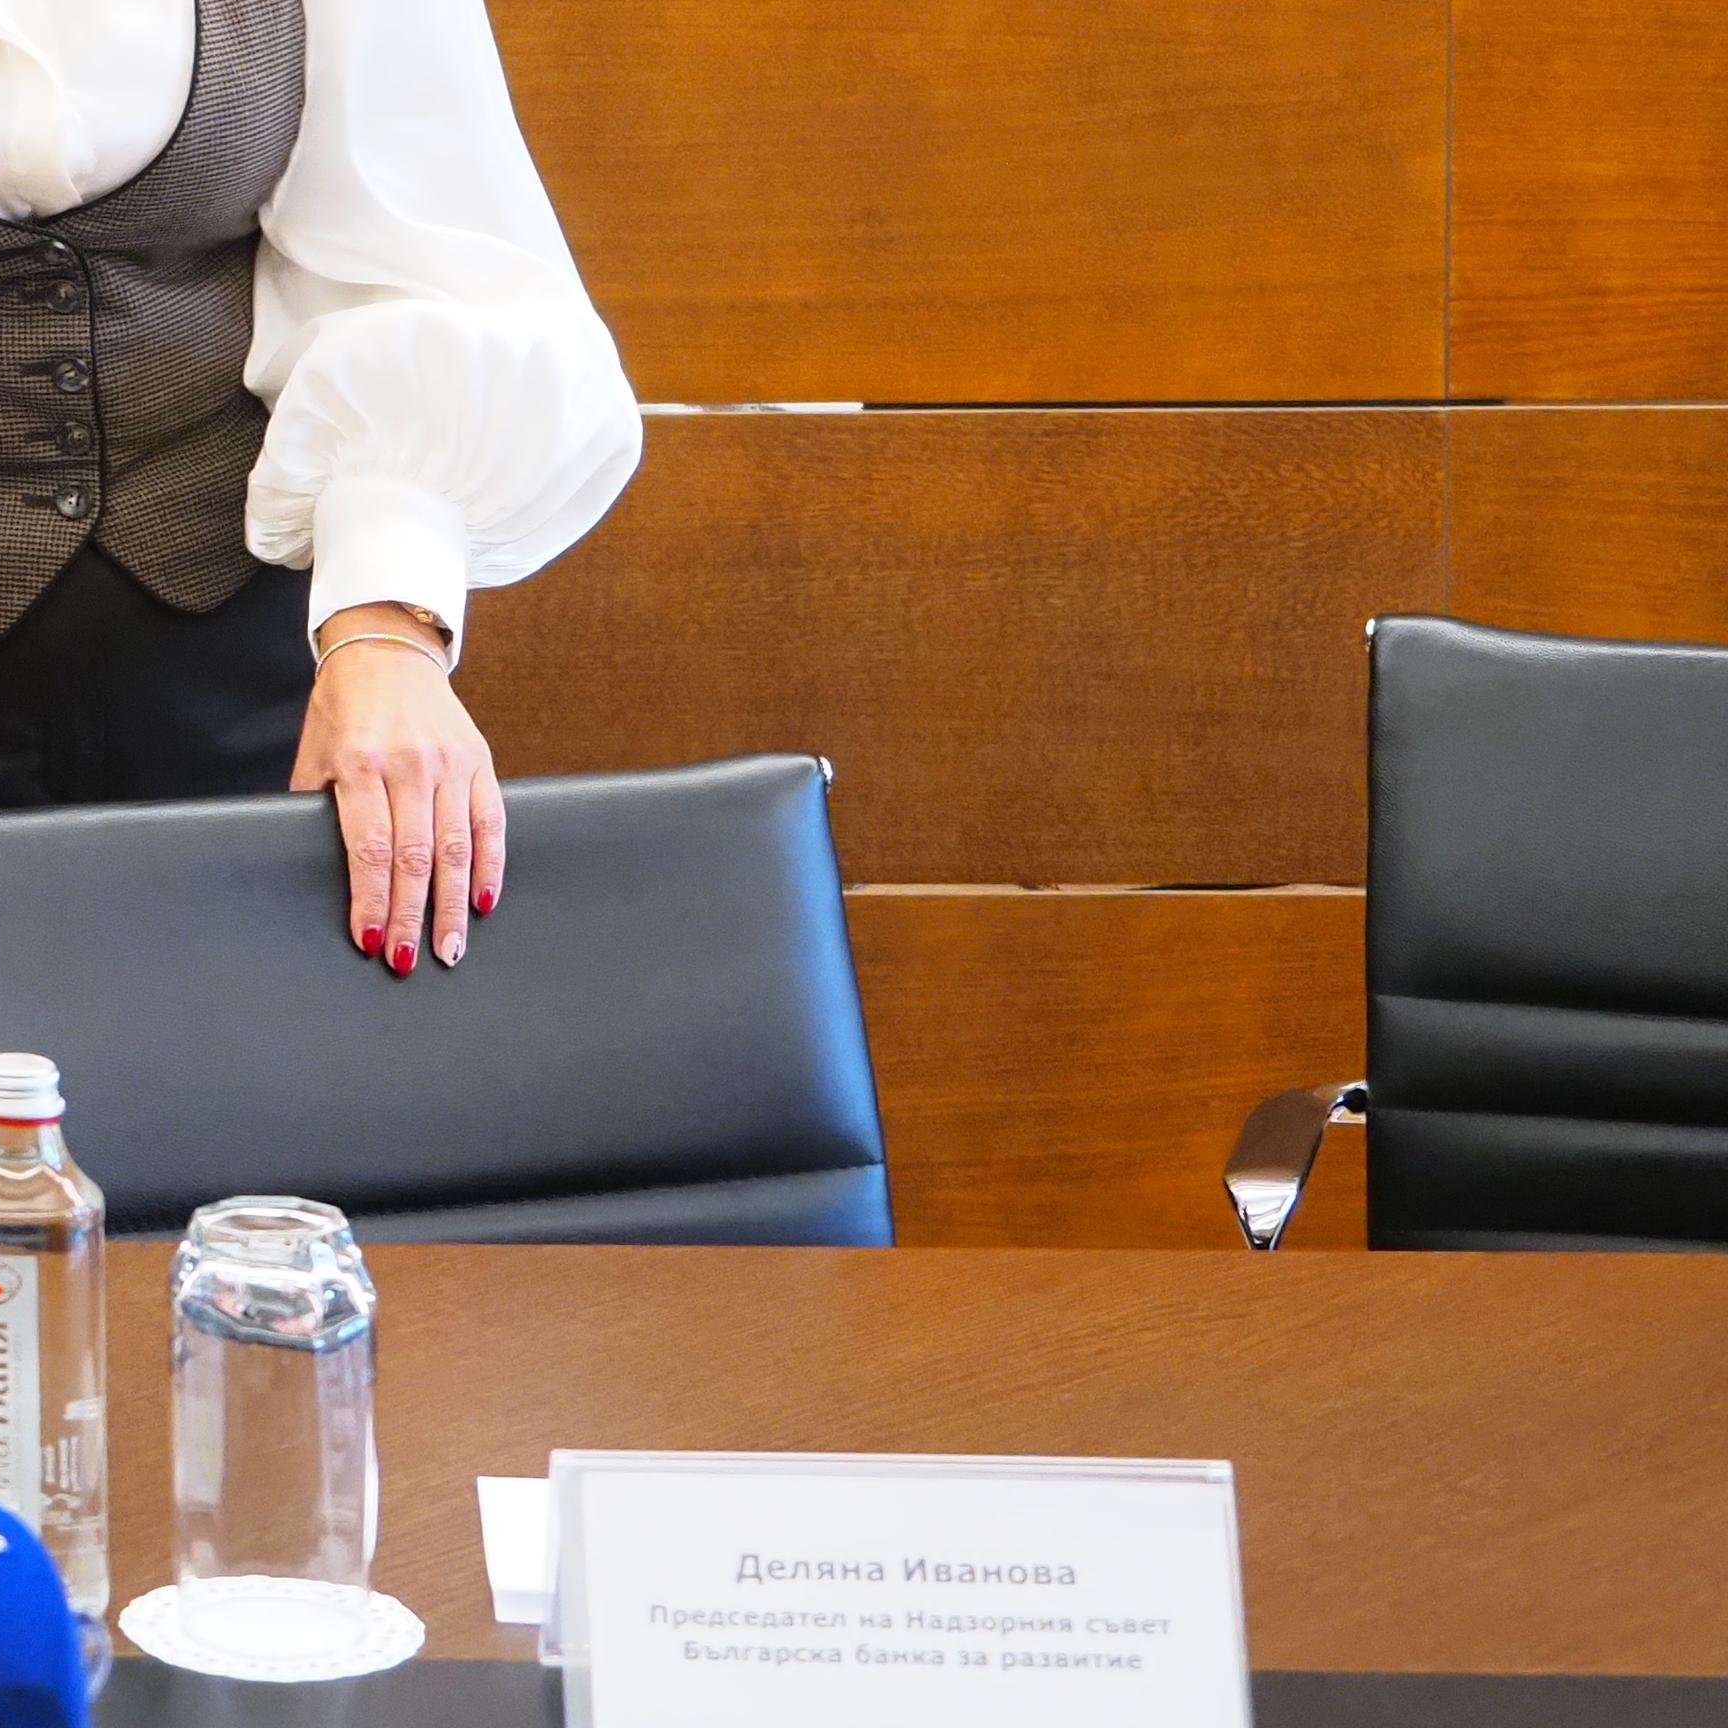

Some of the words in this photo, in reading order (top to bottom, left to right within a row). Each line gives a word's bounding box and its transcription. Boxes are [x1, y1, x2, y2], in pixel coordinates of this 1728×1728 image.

[734, 1552, 887, 1585] Деляна
[901, 1556, 1077, 1586] Иванова
[649, 1603, 848, 1630] Председател
[858, 1612, 894, 1630] на
[905, 1610, 1075, 1636] Надзорния
[1084, 1616, 1172, 1637] съвет
[682, 1639, 843, 1668] Българска
[854, 1642, 946, 1667] банка
[957, 1650, 990, 1667] за
[1000, 1651, 1144, 1672] развитие
